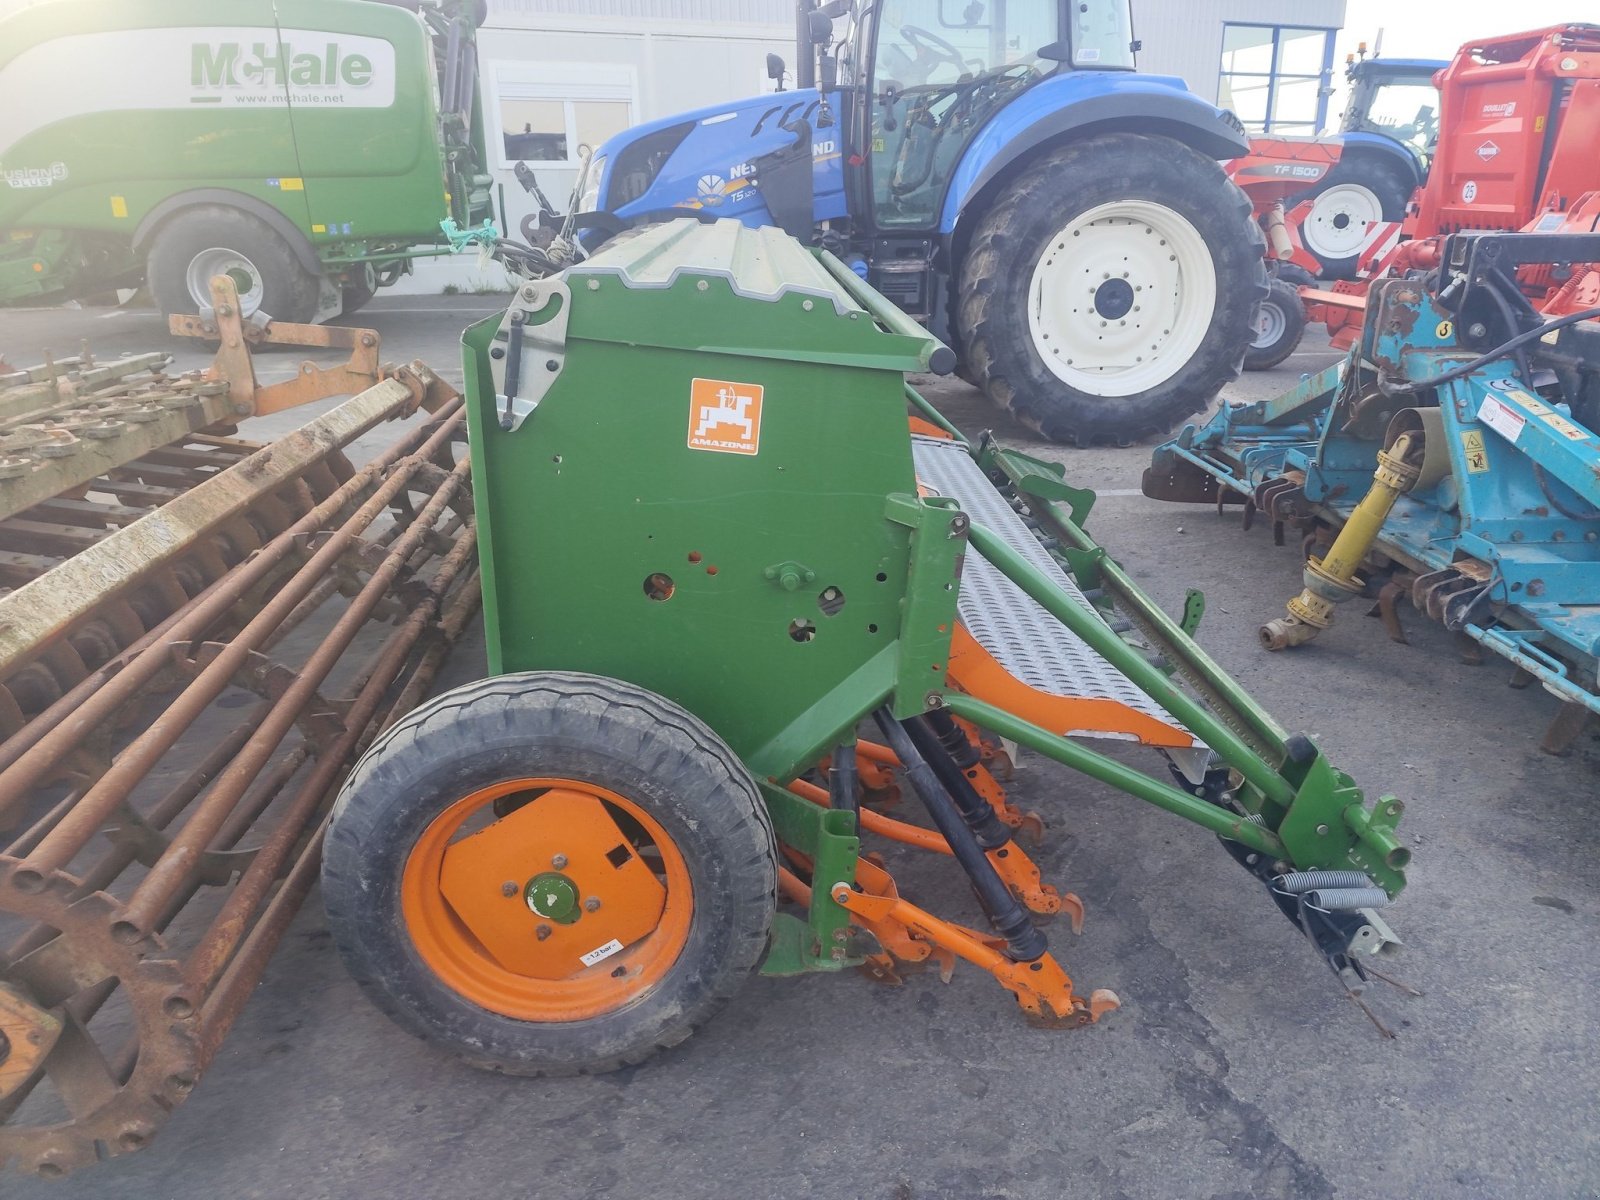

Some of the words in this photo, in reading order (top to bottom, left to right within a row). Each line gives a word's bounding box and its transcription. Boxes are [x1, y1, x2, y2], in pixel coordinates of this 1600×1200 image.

[190, 42, 373, 87] McHale
[235, 93, 345, 103] www.mchale.net
[1274, 165, 1290, 174] TF
[1292, 167, 1320, 177] 1500
[1464, 184, 1475, 199] 25
[690, 437, 755, 451] AMAZONE
